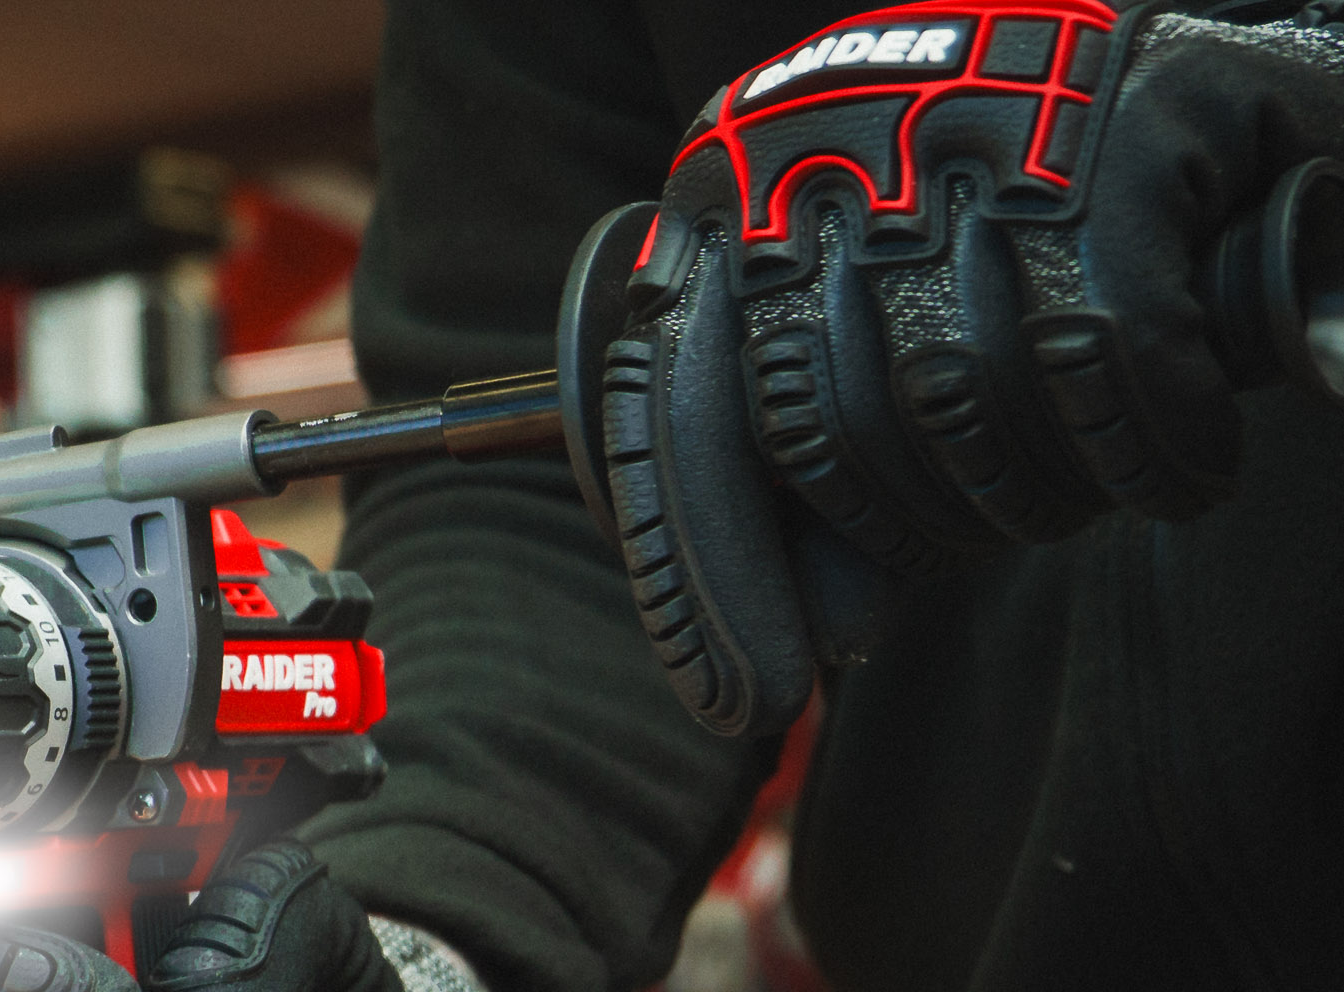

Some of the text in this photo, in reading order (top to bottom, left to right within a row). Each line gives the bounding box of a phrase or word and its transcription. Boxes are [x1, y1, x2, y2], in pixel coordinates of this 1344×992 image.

[743, 28, 958, 99] RAIDER
[39, 621, 60, 647] 10
[221, 654, 336, 691] RAIDER
[54, 707, 68, 721] 8
[302, 691, 337, 718] Pro
